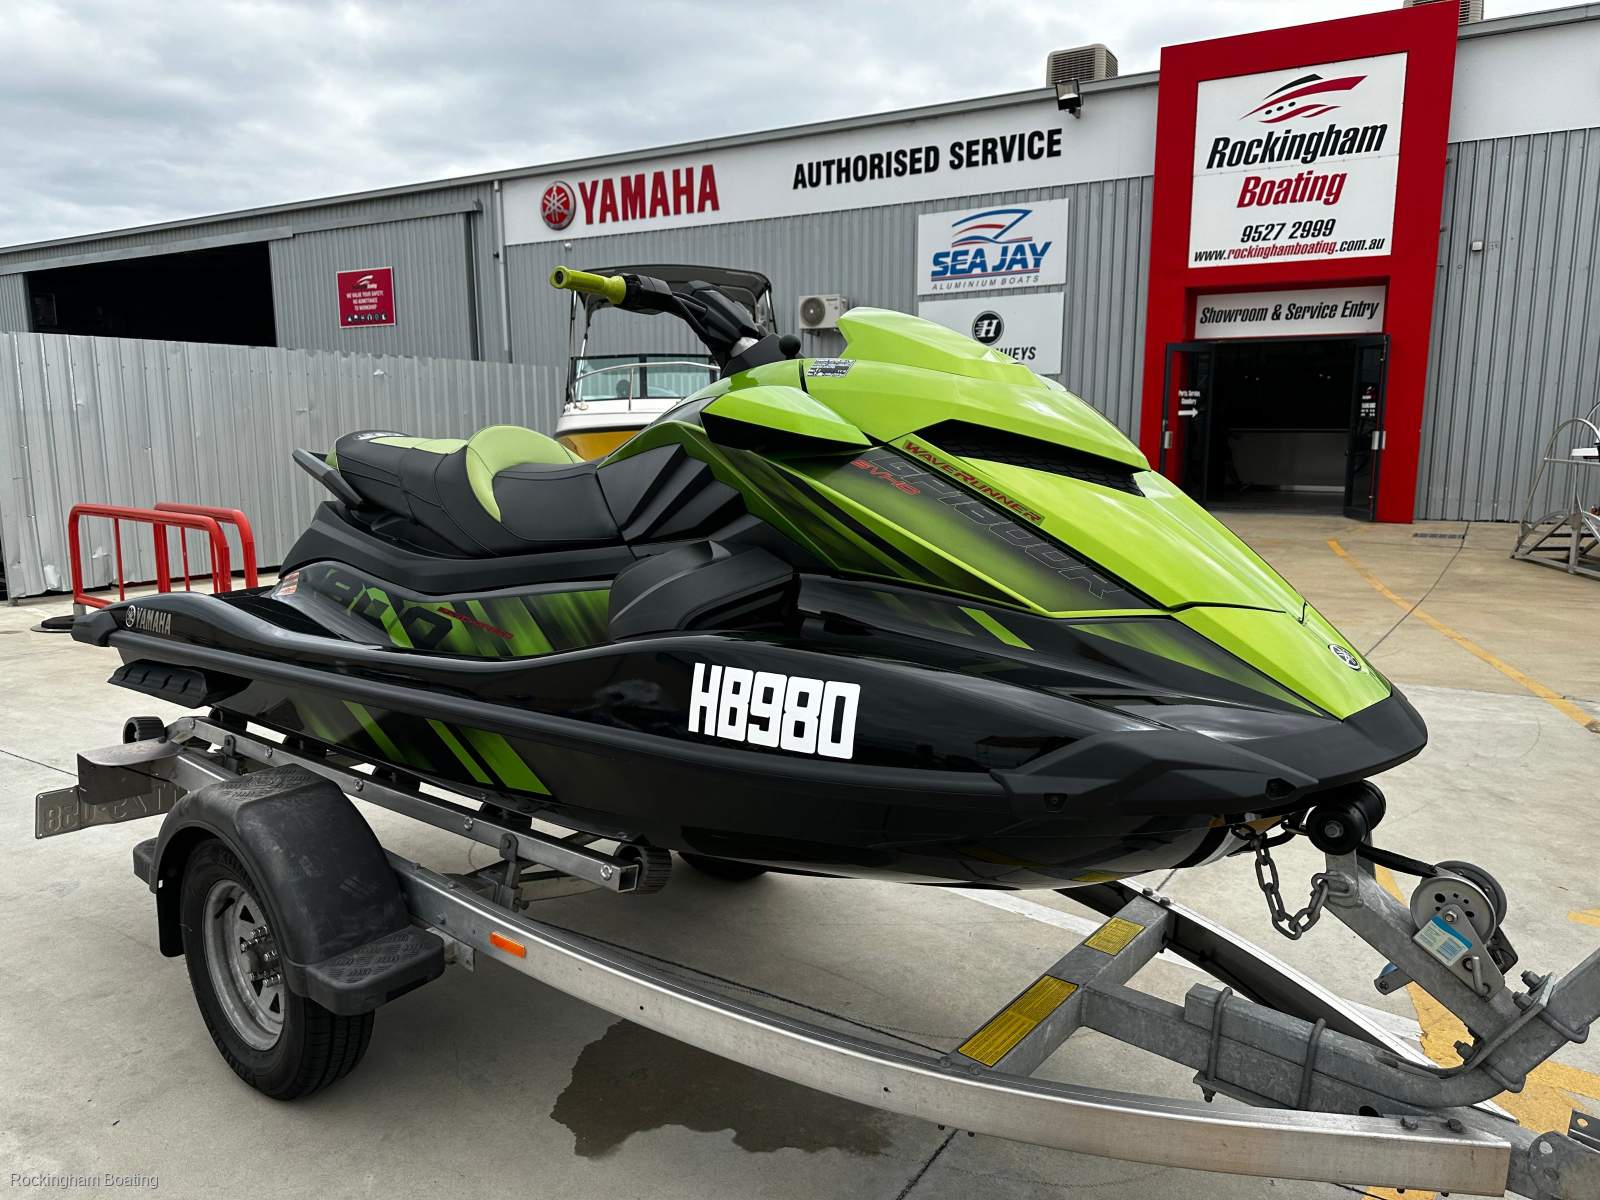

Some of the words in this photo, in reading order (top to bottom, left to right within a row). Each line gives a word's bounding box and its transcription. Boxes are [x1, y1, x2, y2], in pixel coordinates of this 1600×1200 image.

[793, 146, 940, 189] AUTHORISED
[949, 128, 1062, 170] SERVICE
[1206, 123, 1388, 169] Rockingham
[578, 164, 720, 225] YAMAHA
[1236, 170, 1347, 208] Boating
[1240, 223, 1286, 243] 9527
[1289, 218, 1336, 239] 2999
[931, 248, 988, 277] SEA
[992, 241, 1052, 271] JAY
[1194, 238, 1385, 262] www.rockinghamboating.com.au
[932, 279, 997, 290] ALUMINIUM
[1001, 275, 1040, 286] BOATS
[1200, 307, 1269, 324] Showroom
[1271, 304, 1282, 321] &
[1285, 302, 1338, 320] Service
[1340, 301, 1380, 320] Entry
[996, 346, 1036, 361] UEYS
[904, 440, 1042, 522] WAVERUNNER
[136, 607, 172, 636] YAMAHA
[688, 662, 861, 760] HB980
